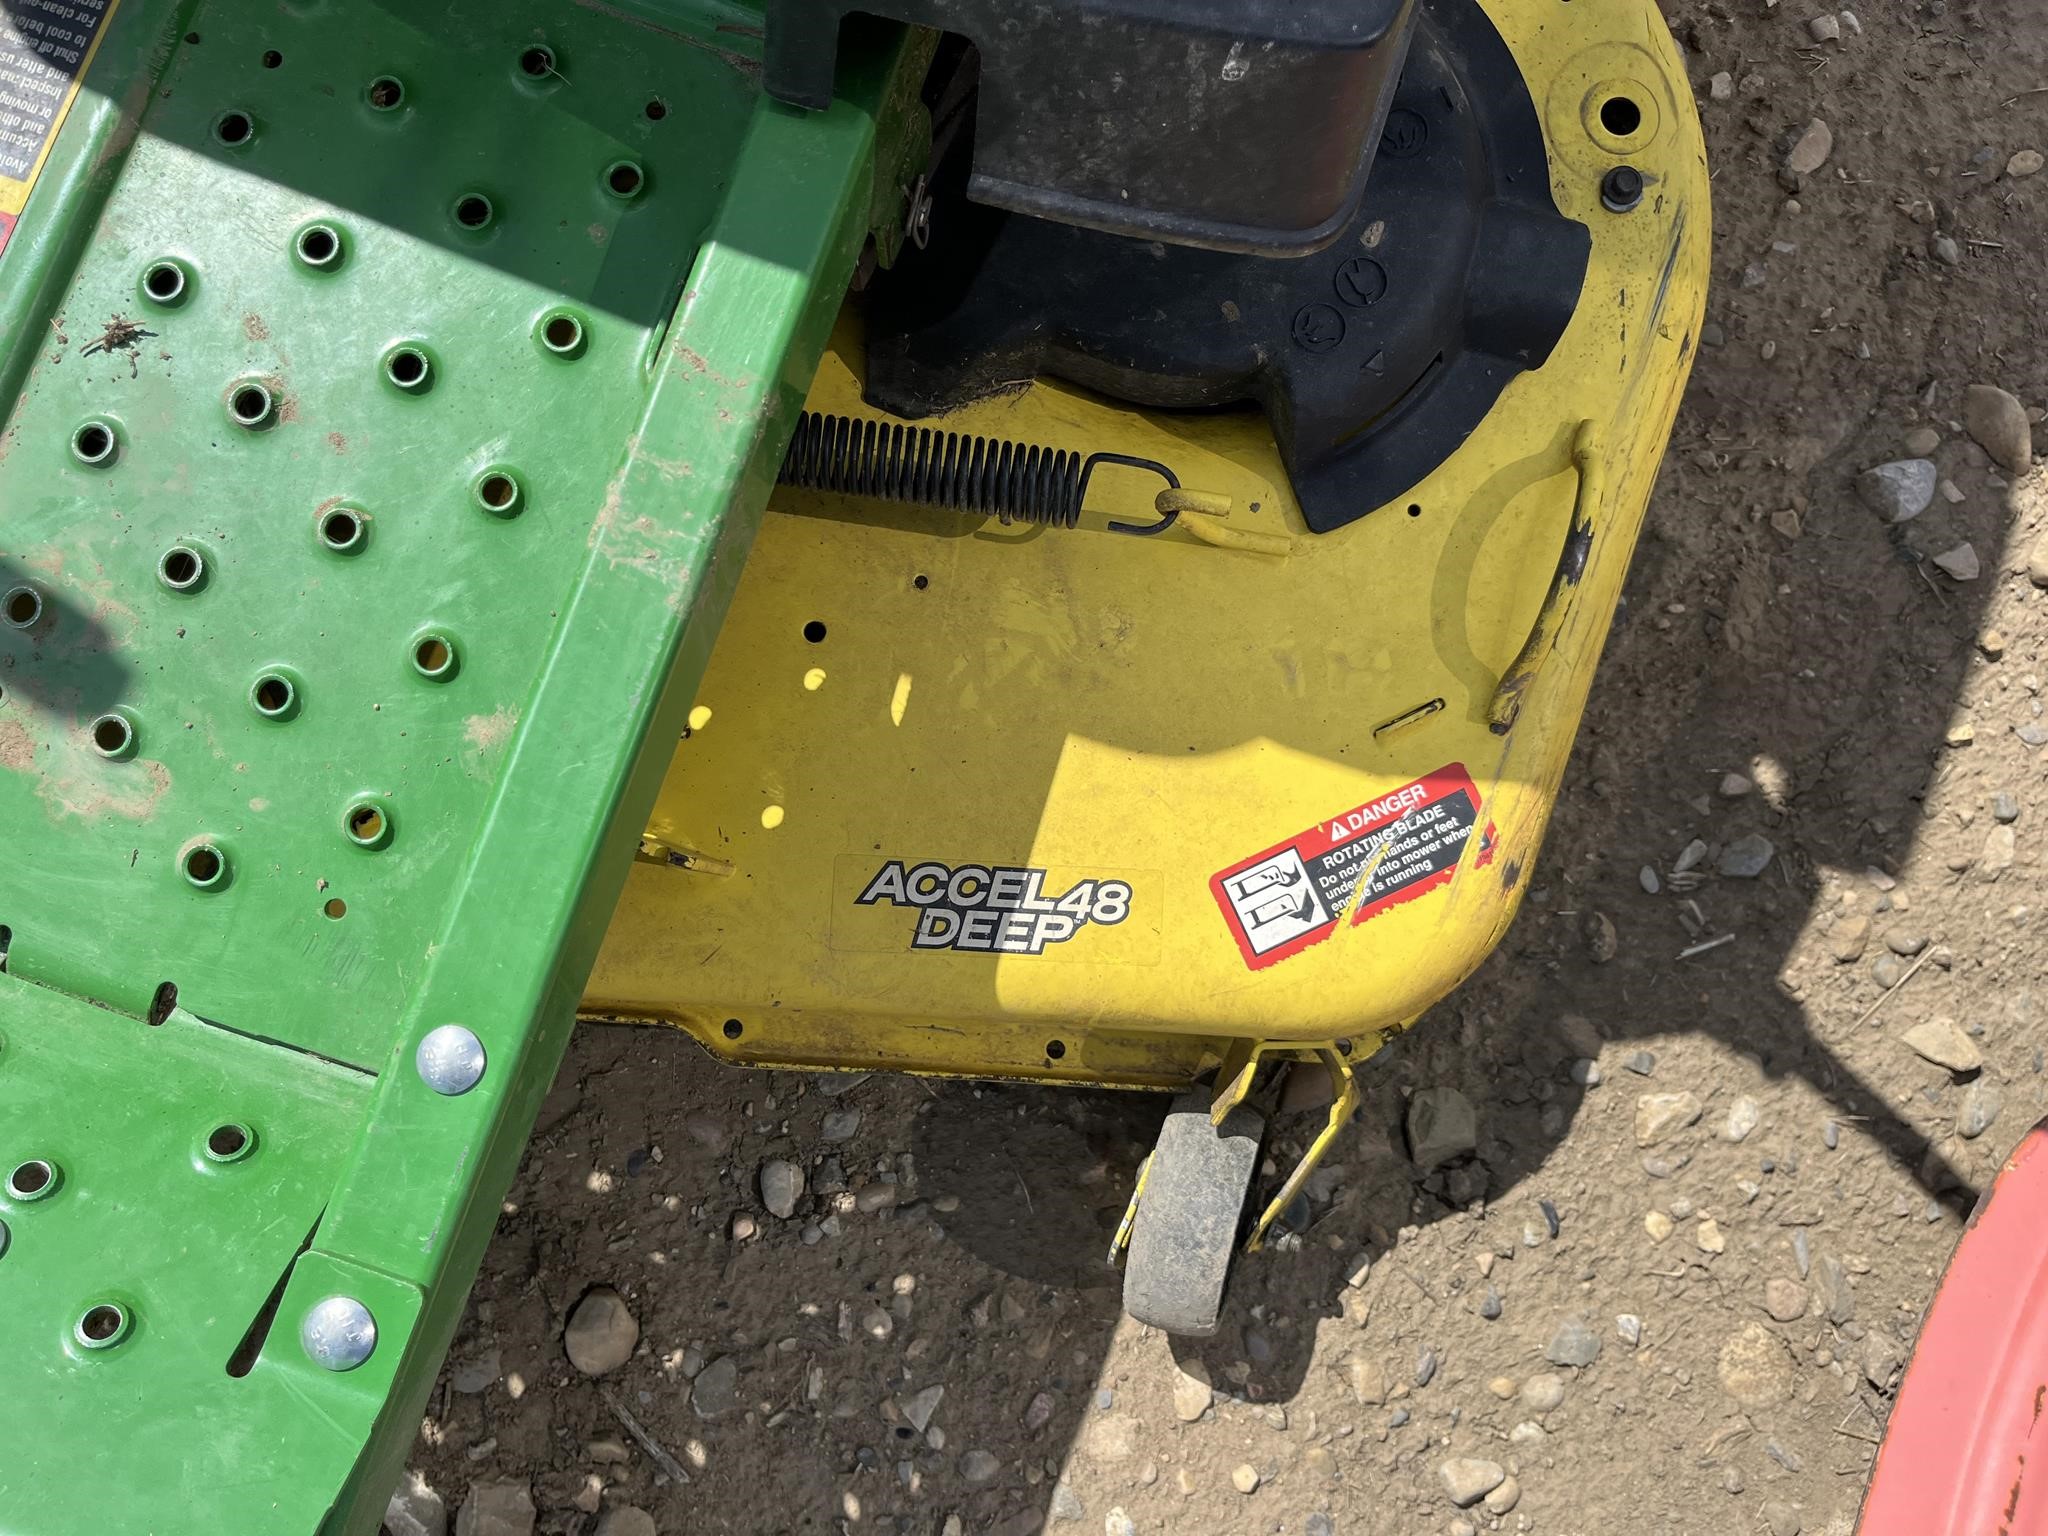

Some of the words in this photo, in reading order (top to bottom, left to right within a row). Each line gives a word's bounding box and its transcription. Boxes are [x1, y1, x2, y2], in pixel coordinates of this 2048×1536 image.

[6, 12, 44, 34] before
[76, 12, 96, 28] For
[3, 29, 39, 48] engine
[45, 25, 72, 41] cool
[74, 35, 87, 48] to
[38, 41, 54, 53] off
[53, 46, 79, 64] Shut
[0, 69, 20, 83] ma
[16, 58, 45, 74] after
[45, 66, 70, 81] and
[20, 76, 62, 99] Inspect
[0, 90, 37, 114] moving
[38, 107, 52, 119] or
[22, 119, 45, 135] and
[1347, 784, 1428, 831] DANGER
[1322, 826, 1396, 869] ROTATING
[1397, 804, 1446, 835] BLADE
[1421, 829, 1434, 842] or
[1435, 816, 1460, 834] feet
[1376, 860, 1400, 877] into
[1401, 842, 1443, 865] mower
[1443, 824, 1473, 846] when
[1319, 873, 1337, 888] Do
[1339, 861, 1361, 880] not
[1372, 882, 1385, 893] is
[1386, 859, 1433, 886] running
[855, 861, 1056, 910] ACCEL
[1056, 880, 1133, 925] 48
[912, 907, 1075, 954] DEEP
